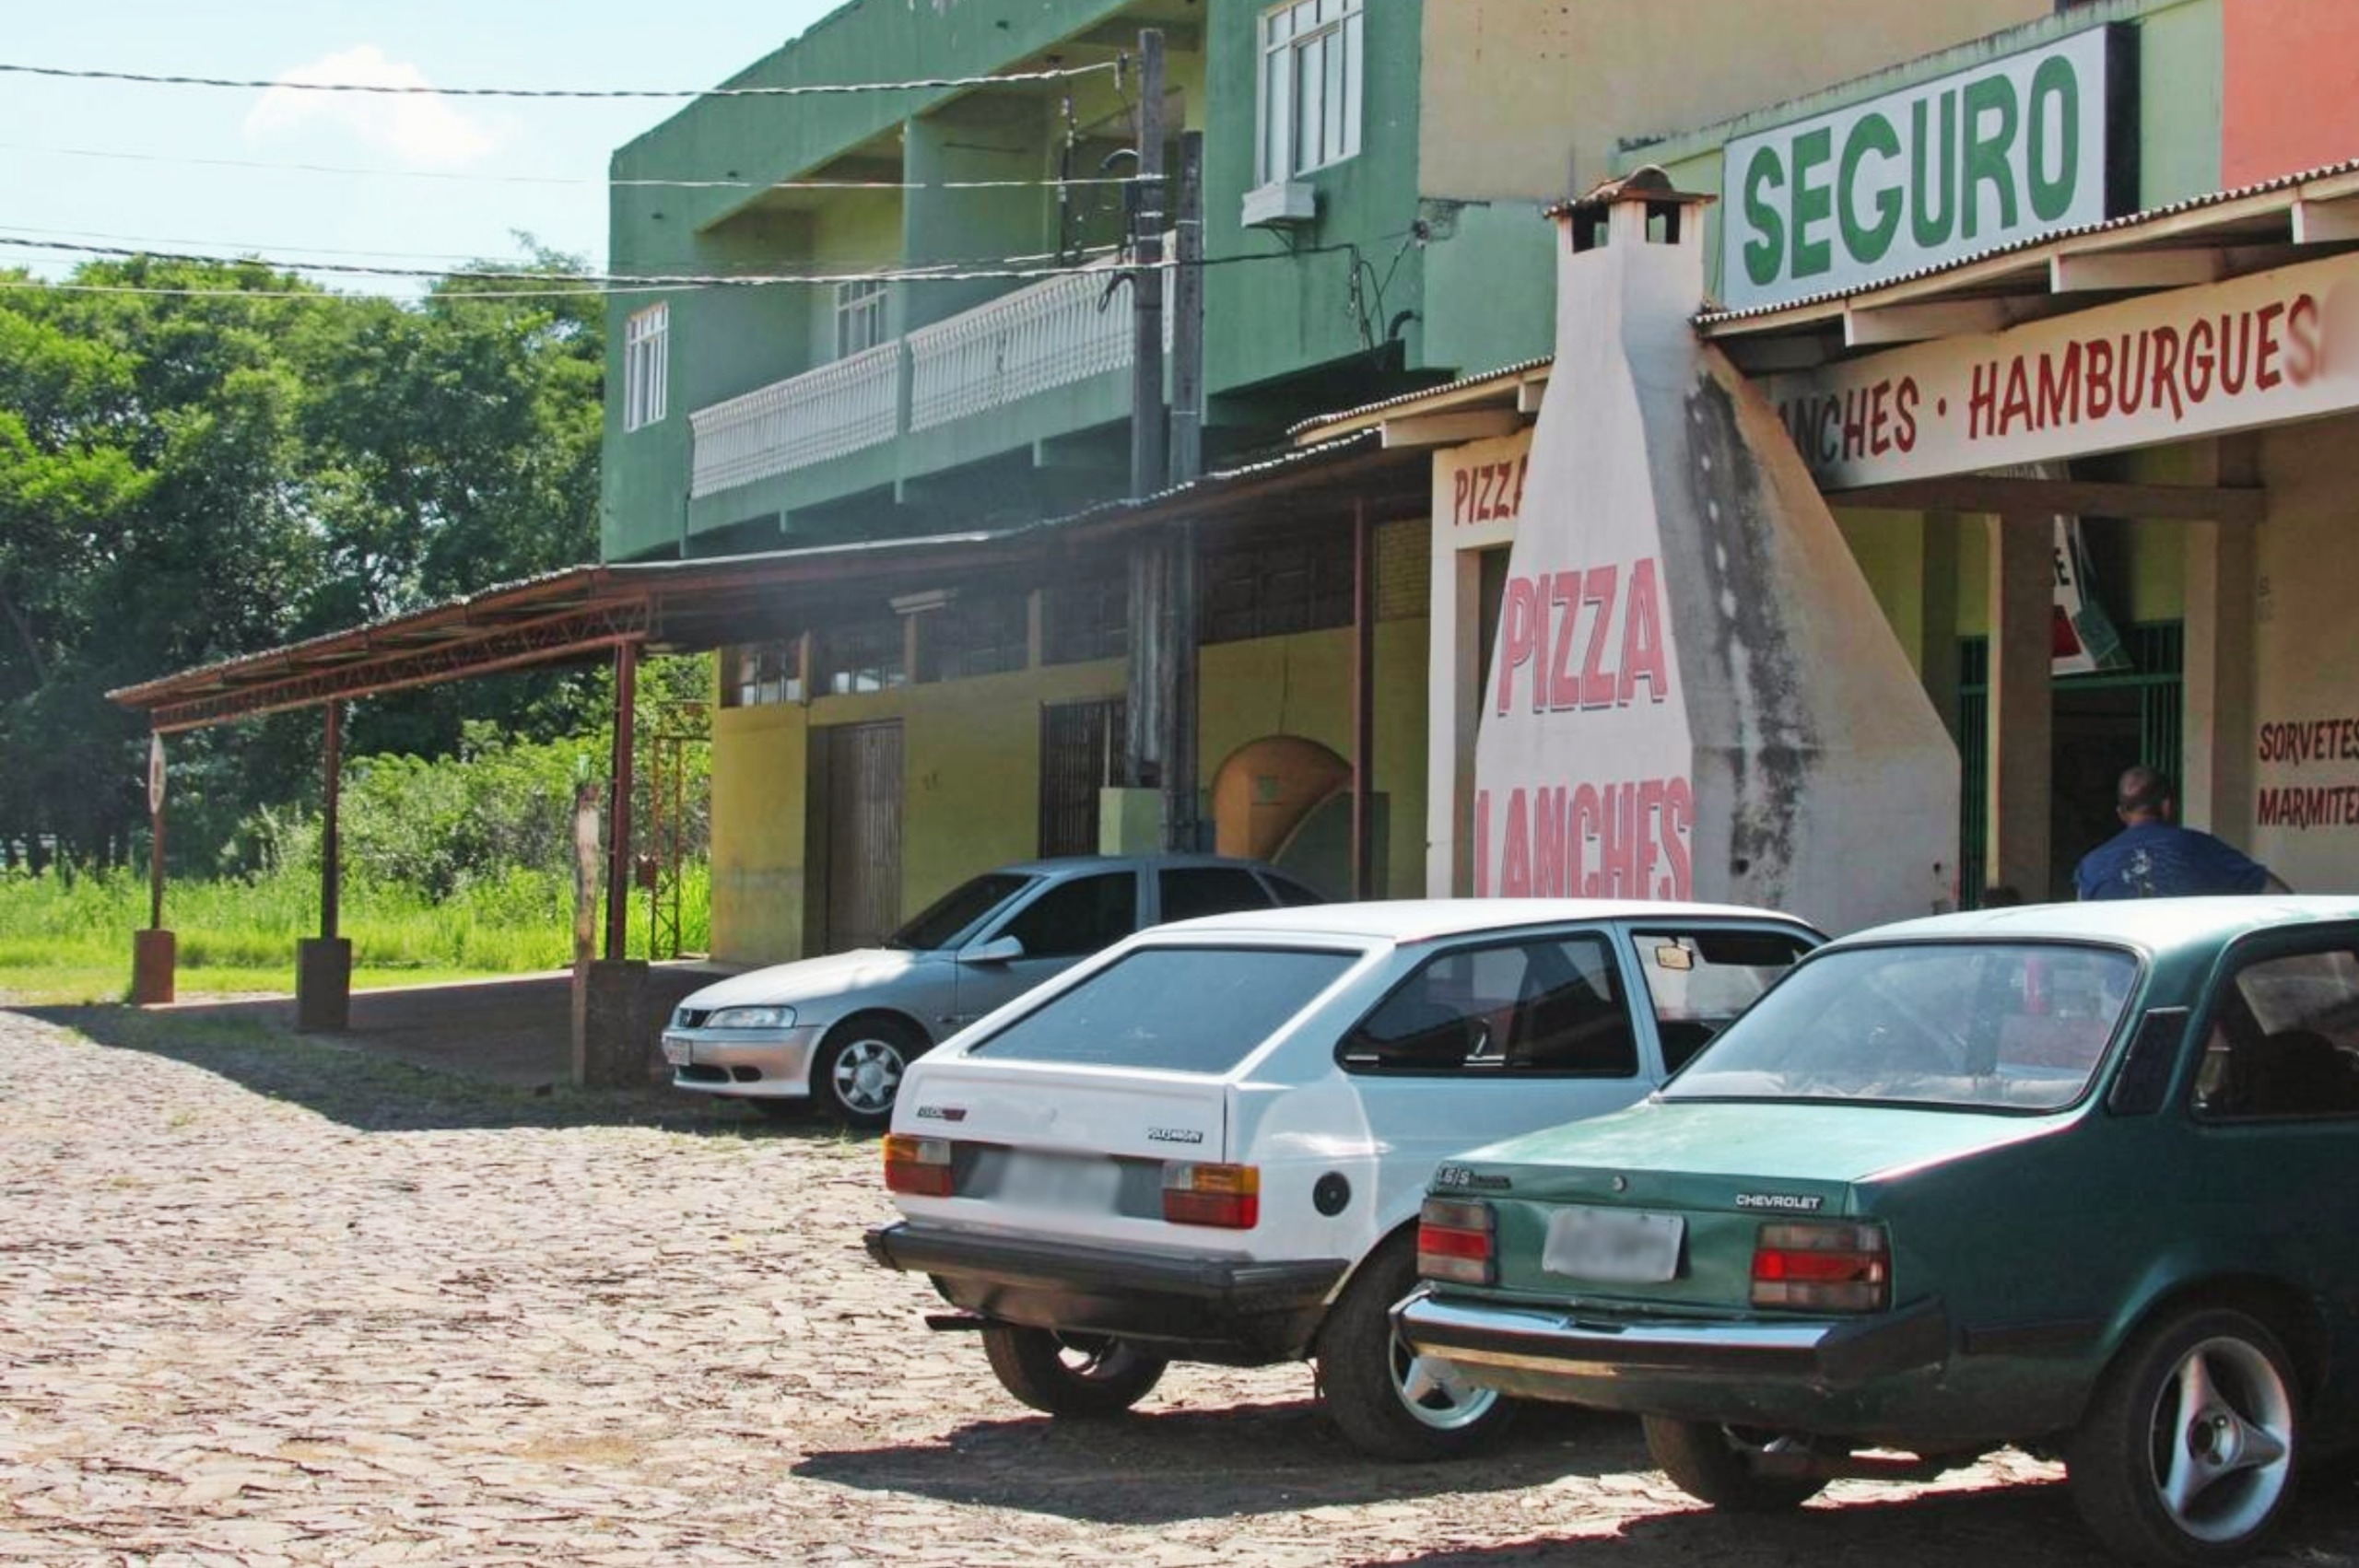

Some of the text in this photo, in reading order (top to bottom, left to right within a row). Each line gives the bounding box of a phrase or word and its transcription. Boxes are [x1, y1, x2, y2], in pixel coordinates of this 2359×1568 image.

[1743, 54, 2079, 286] SEGURO
[1969, 294, 2320, 439] HAMBURGUES
[1497, 558, 1668, 717] PIZZA
[1476, 777, 1696, 899] LANCHES
[2258, 785, 2359, 830] MARMITE
[1735, 1194, 1821, 1210] CHEVROLET
